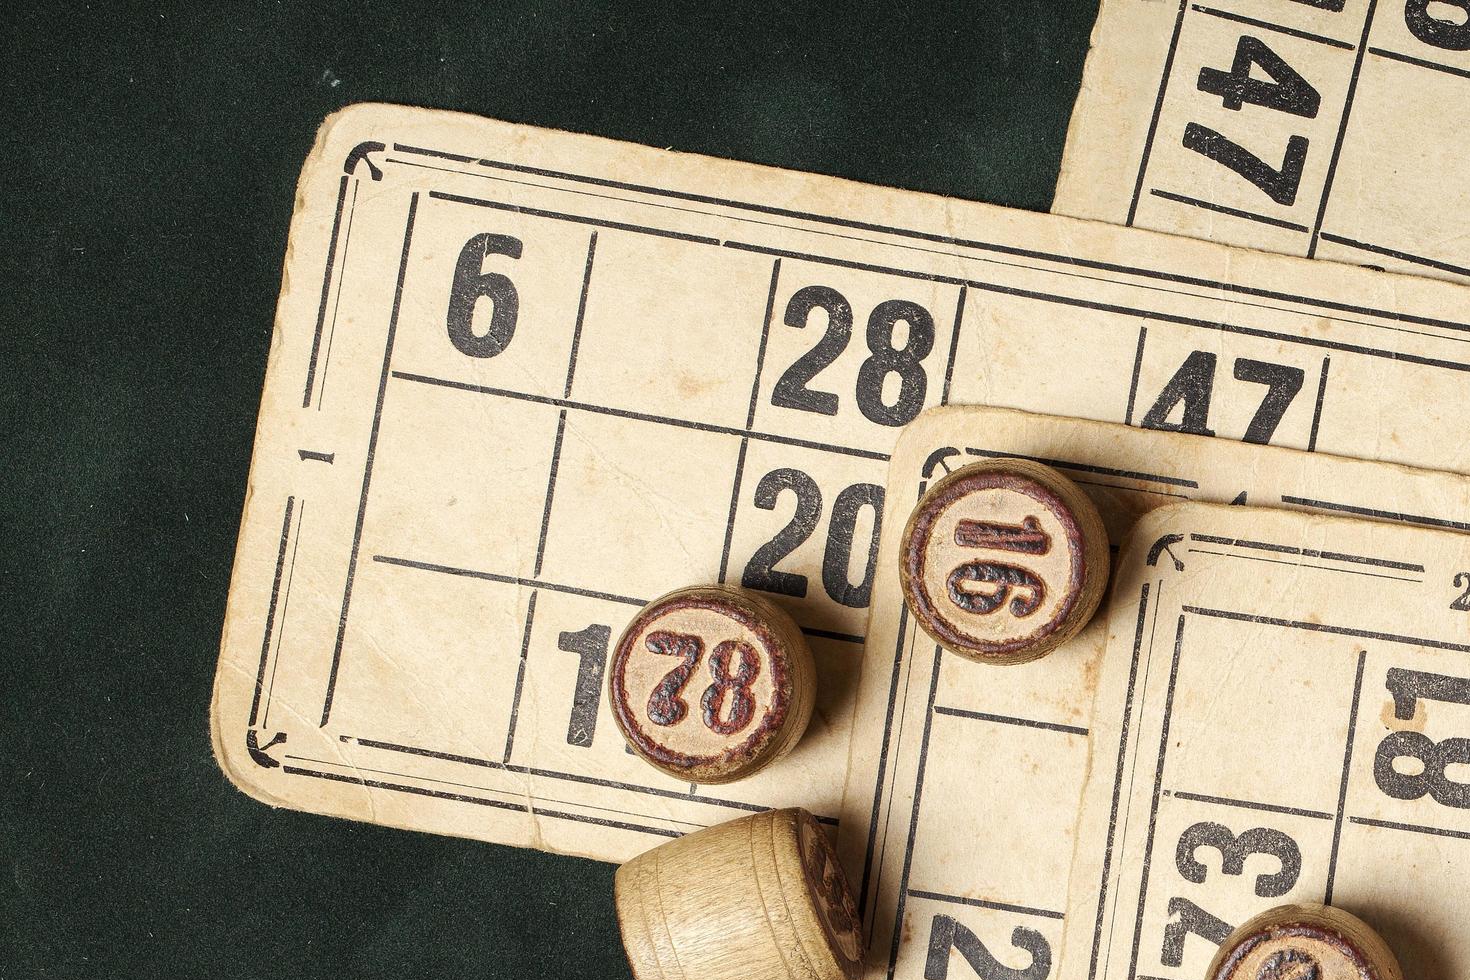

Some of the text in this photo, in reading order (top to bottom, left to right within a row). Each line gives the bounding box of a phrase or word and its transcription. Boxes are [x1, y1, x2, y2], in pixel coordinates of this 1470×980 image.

[1183, 36, 1321, 206] 47
[448, 233, 522, 358] 6
[772, 286, 934, 426] 28
[300, 450, 334, 464] 1
[1142, 350, 1304, 444] 47
[742, 467, 884, 609] 20
[945, 514, 1052, 619] 16
[559, 624, 614, 748] 1
[645, 630, 760, 735] 78
[1161, 822, 1301, 968] 73
